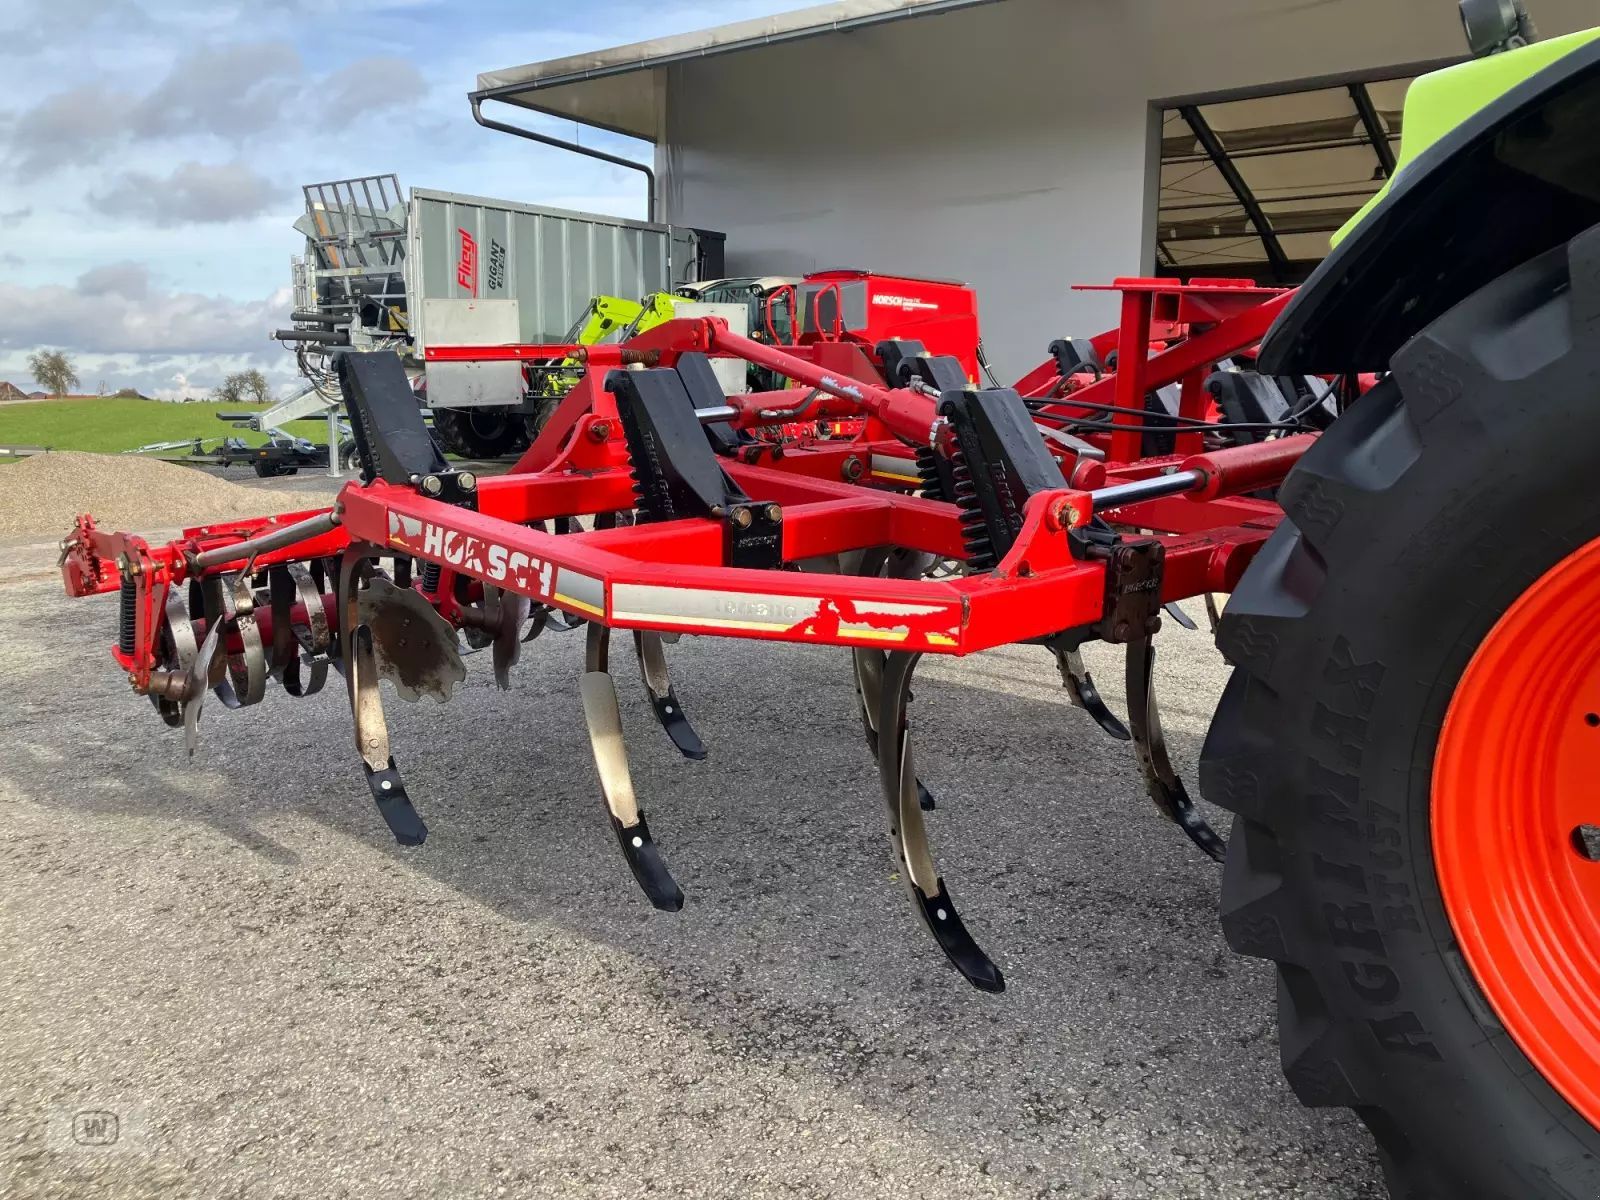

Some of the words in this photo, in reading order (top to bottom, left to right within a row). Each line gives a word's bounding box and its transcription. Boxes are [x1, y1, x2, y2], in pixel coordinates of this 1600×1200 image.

[457, 227, 477, 292] Fliegl
[488, 238, 500, 290] GIGANT
[1308, 633, 1446, 1062] AGRIMAX
